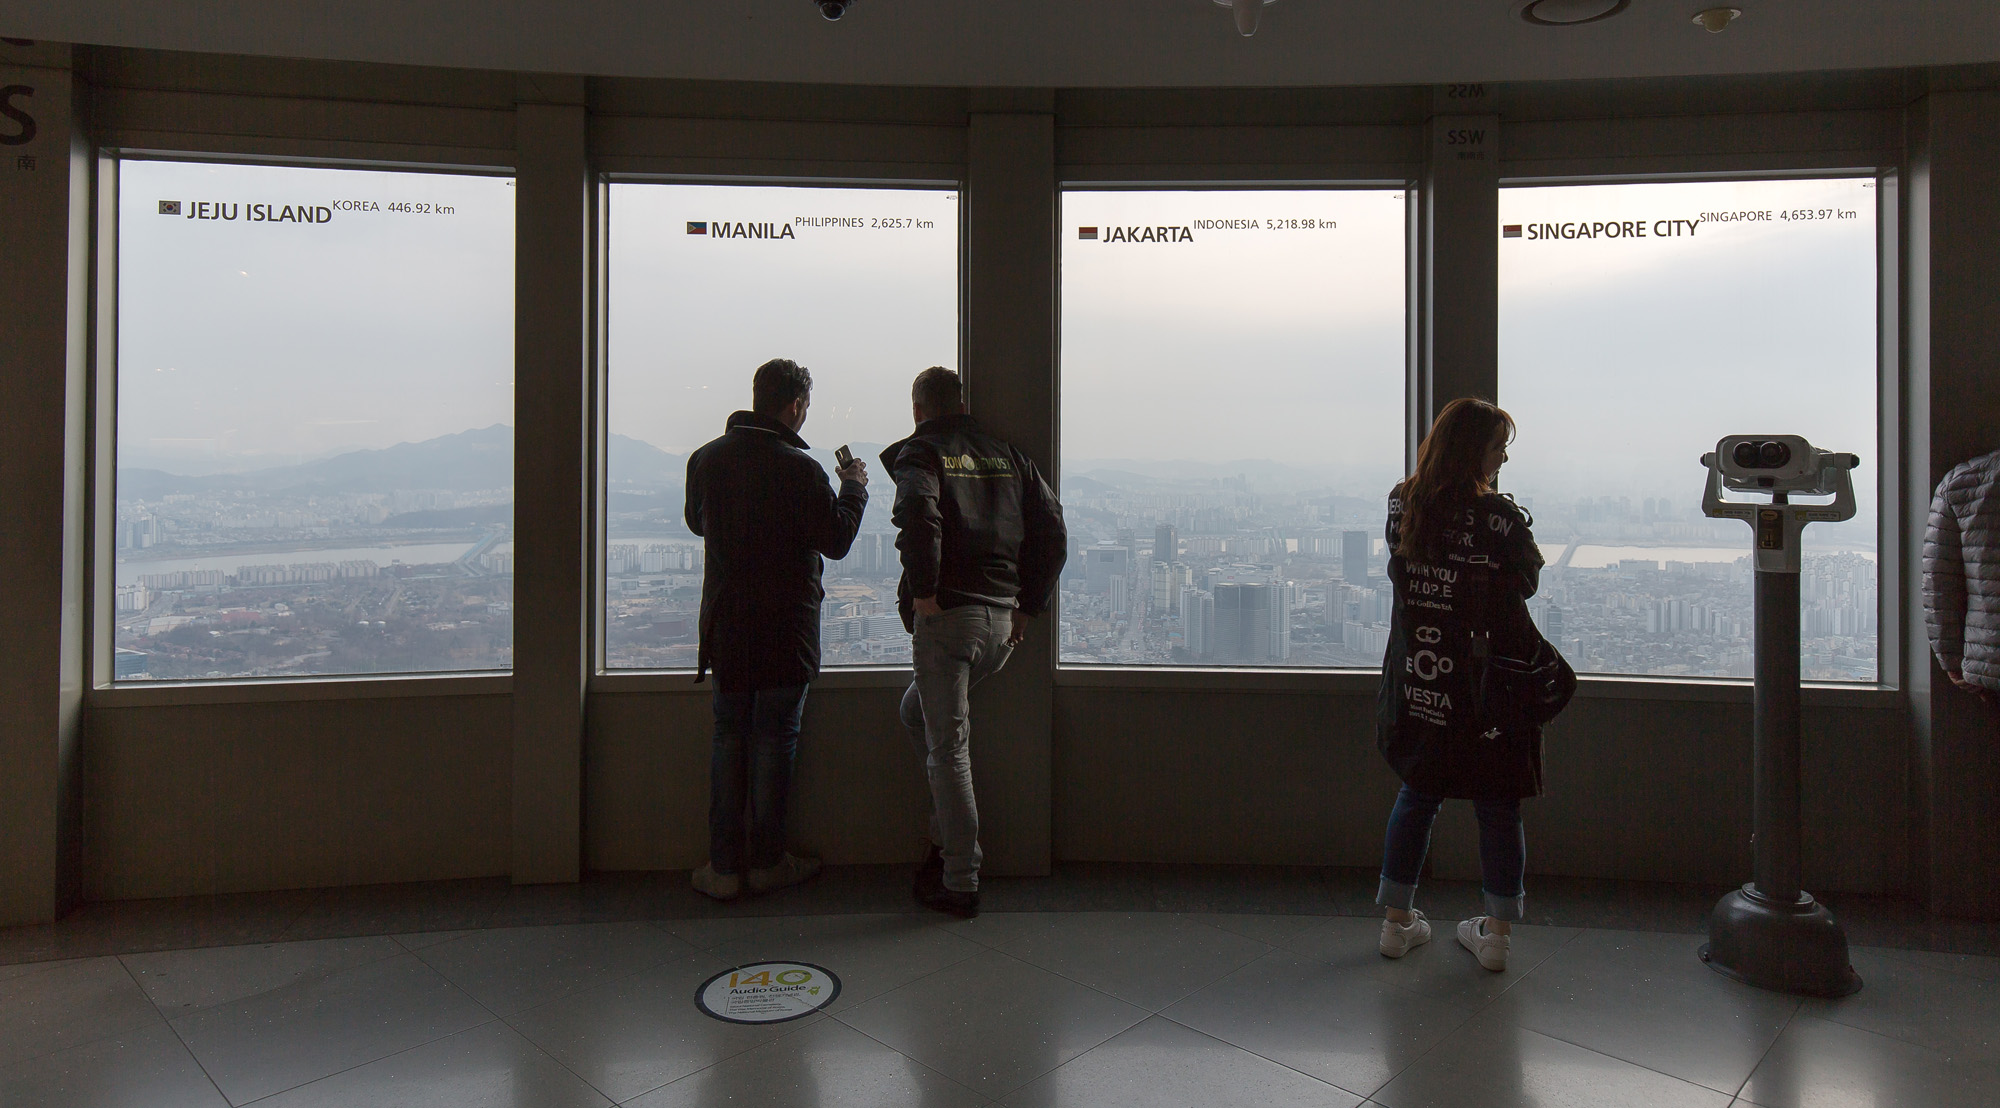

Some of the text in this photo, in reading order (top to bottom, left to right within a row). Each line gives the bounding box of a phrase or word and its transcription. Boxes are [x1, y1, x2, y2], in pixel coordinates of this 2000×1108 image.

[0, 84, 37, 146] S
[1447, 129, 1486, 145] SSW
[187, 199, 455, 224] JEJU ISLAND KOREA 446.92 km
[711, 216, 934, 240] MANILA PHILIPPINES 2,625.7 km
[1102, 218, 1337, 243] JAKARTA INDONESIA 5,218.98 km
[1527, 208, 1857, 241] SINGAPORE CITY SINGAPORE 4,653.97 km
[1431, 566, 1458, 584] YOU
[1404, 683, 1453, 710] VESTA
[729, 984, 806, 995] Audio Guide
